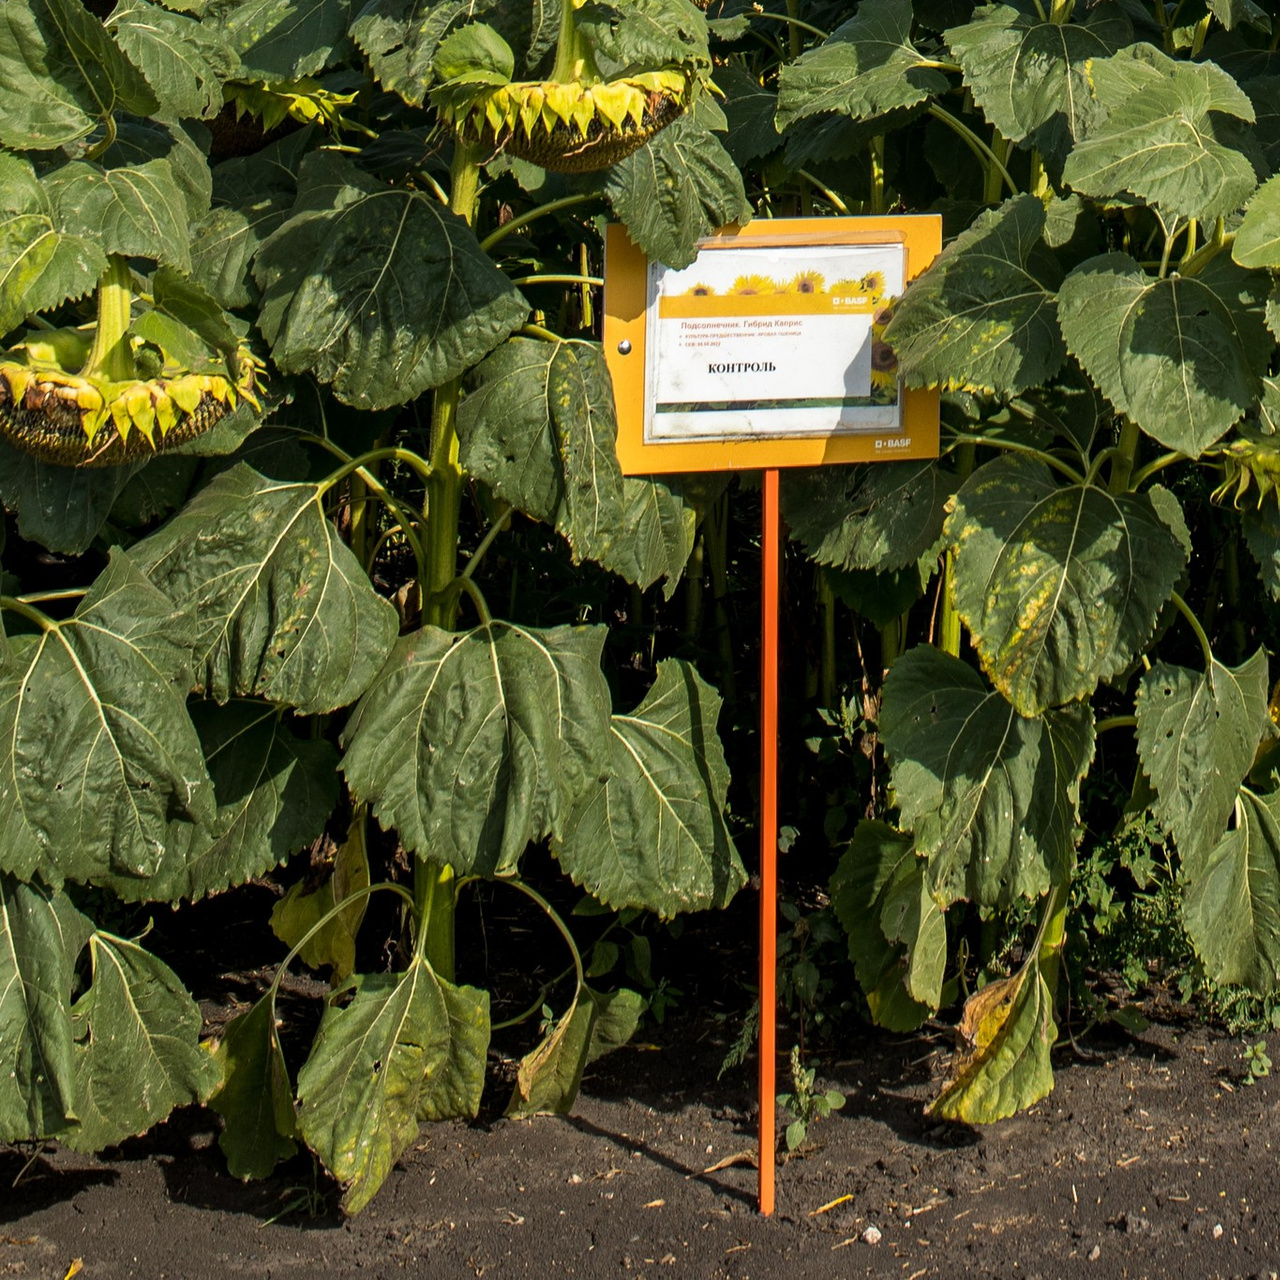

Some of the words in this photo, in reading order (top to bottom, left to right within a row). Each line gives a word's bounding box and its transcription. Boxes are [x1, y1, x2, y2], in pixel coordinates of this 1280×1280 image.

[845, 297, 868, 305] BASF
[743, 320, 773, 329] Гибрид
[774, 319, 803, 328] Каприс
[708, 362, 776, 374] КОНТРОЛЬ
[887, 438, 912, 447] BASF
